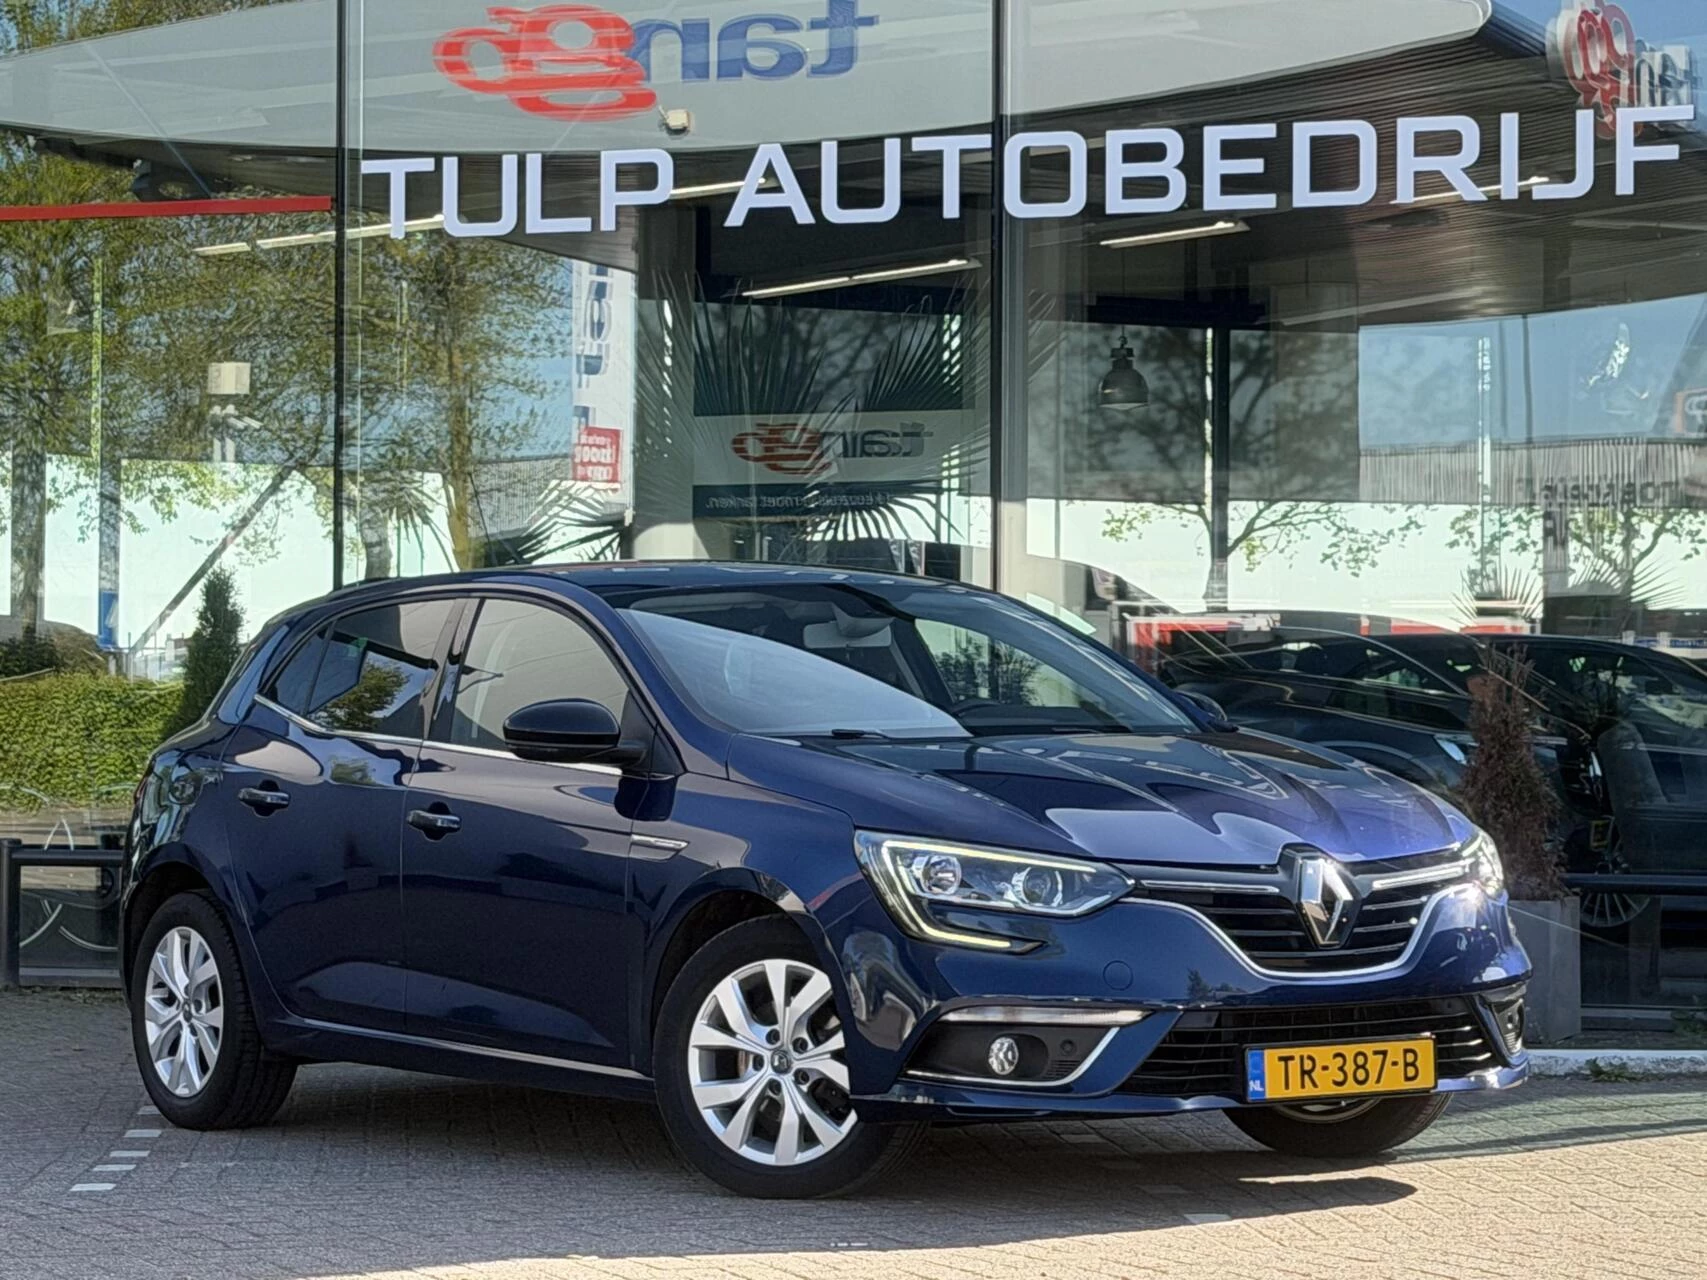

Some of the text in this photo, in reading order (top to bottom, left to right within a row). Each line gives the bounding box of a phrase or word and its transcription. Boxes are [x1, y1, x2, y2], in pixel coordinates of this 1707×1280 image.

[361, 105, 1695, 239] TULP AUTOBEDRIJF
[1249, 1048, 1420, 1092] NL TR-387-B
